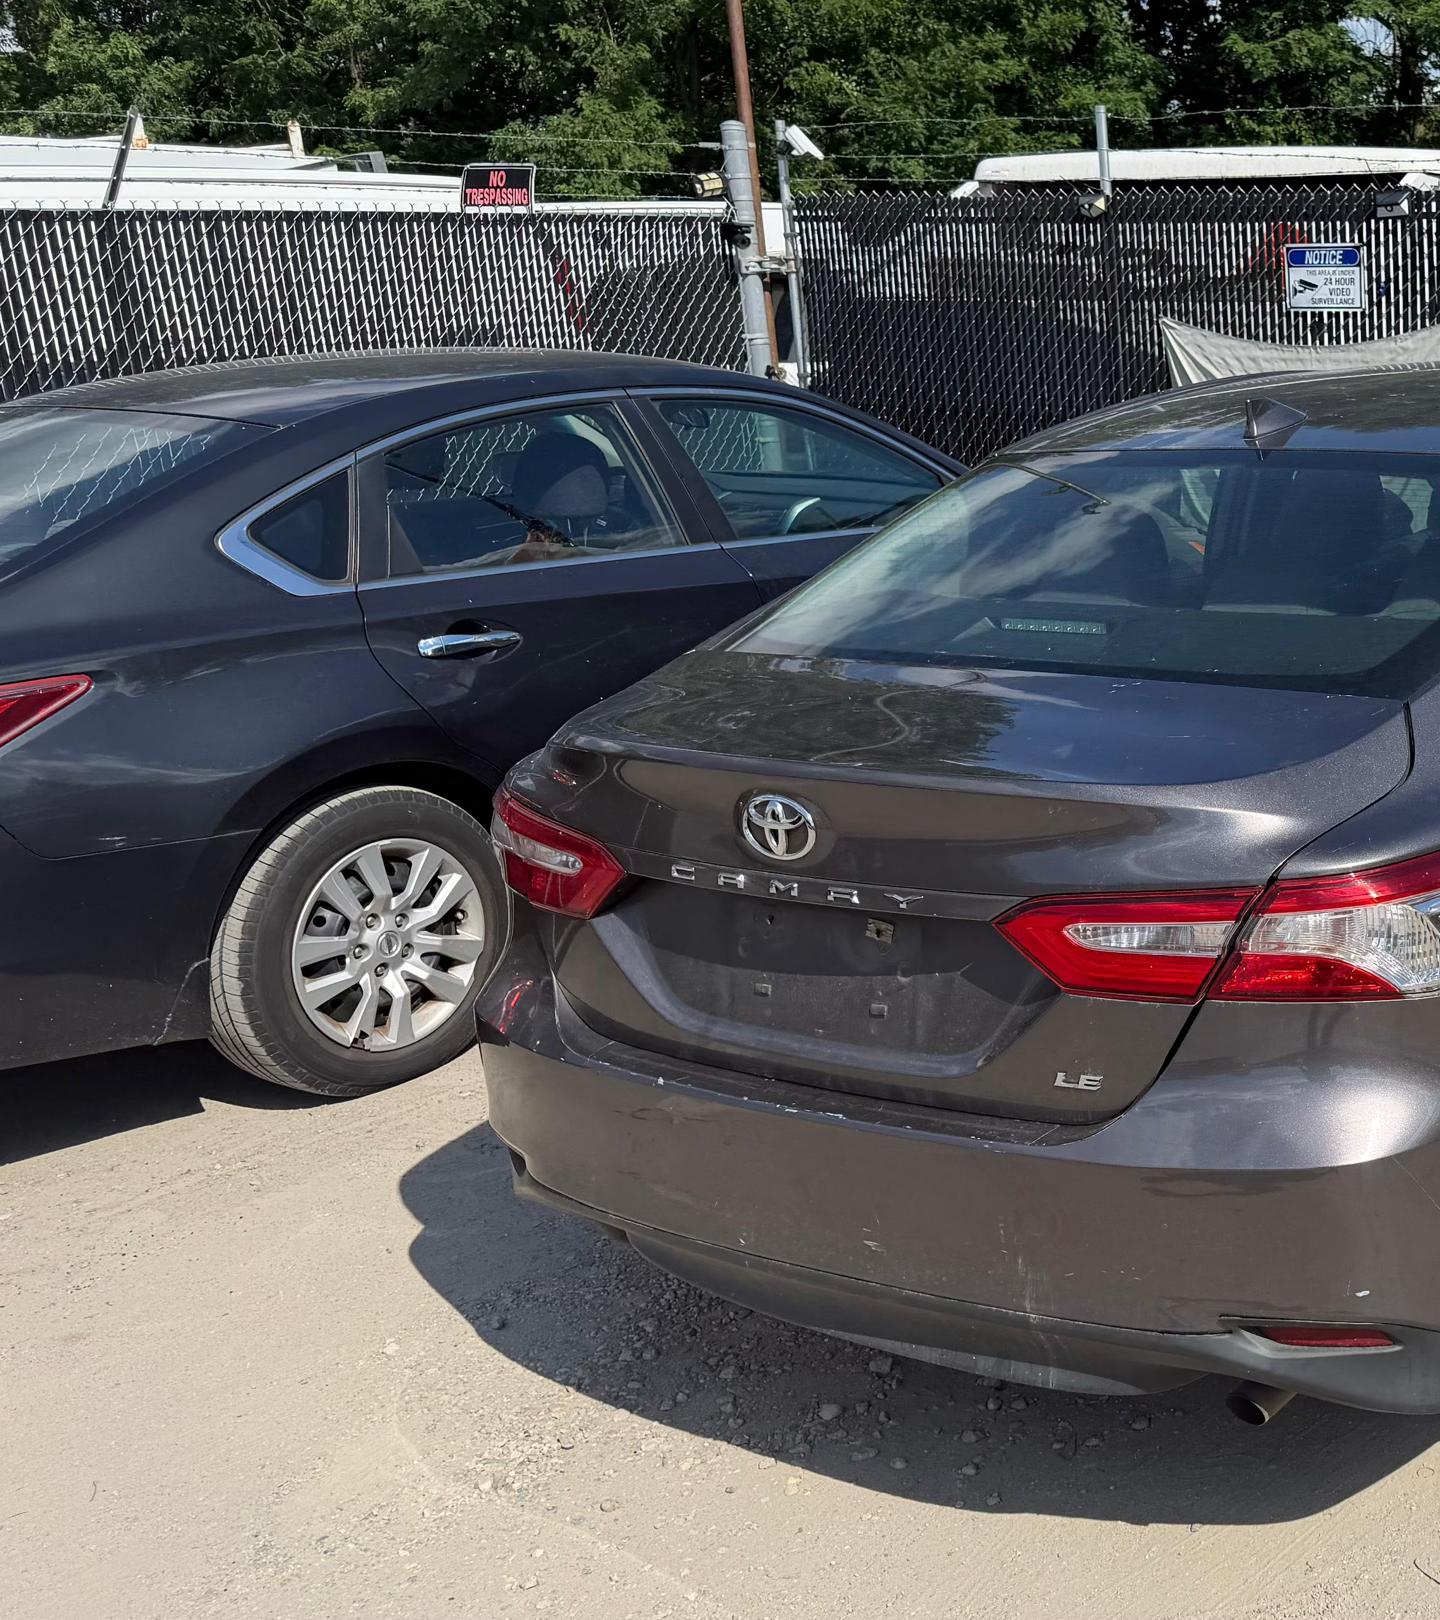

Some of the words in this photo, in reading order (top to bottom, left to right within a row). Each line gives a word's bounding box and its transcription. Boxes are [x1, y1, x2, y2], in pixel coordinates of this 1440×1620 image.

[489, 170, 506, 187] NO
[465, 188, 528, 205] TRESPASSING
[1304, 250, 1344, 265] NOTICE
[1306, 269, 1317, 277] THIS
[1323, 277, 1333, 286] 24
[1334, 277, 1356, 286] HOUR
[1328, 287, 1351, 297] VIDEO
[1311, 297, 1356, 306] SURVEILLANCE
[671, 864, 924, 909] CAMRY
[1054, 1072, 1104, 1091] LE
